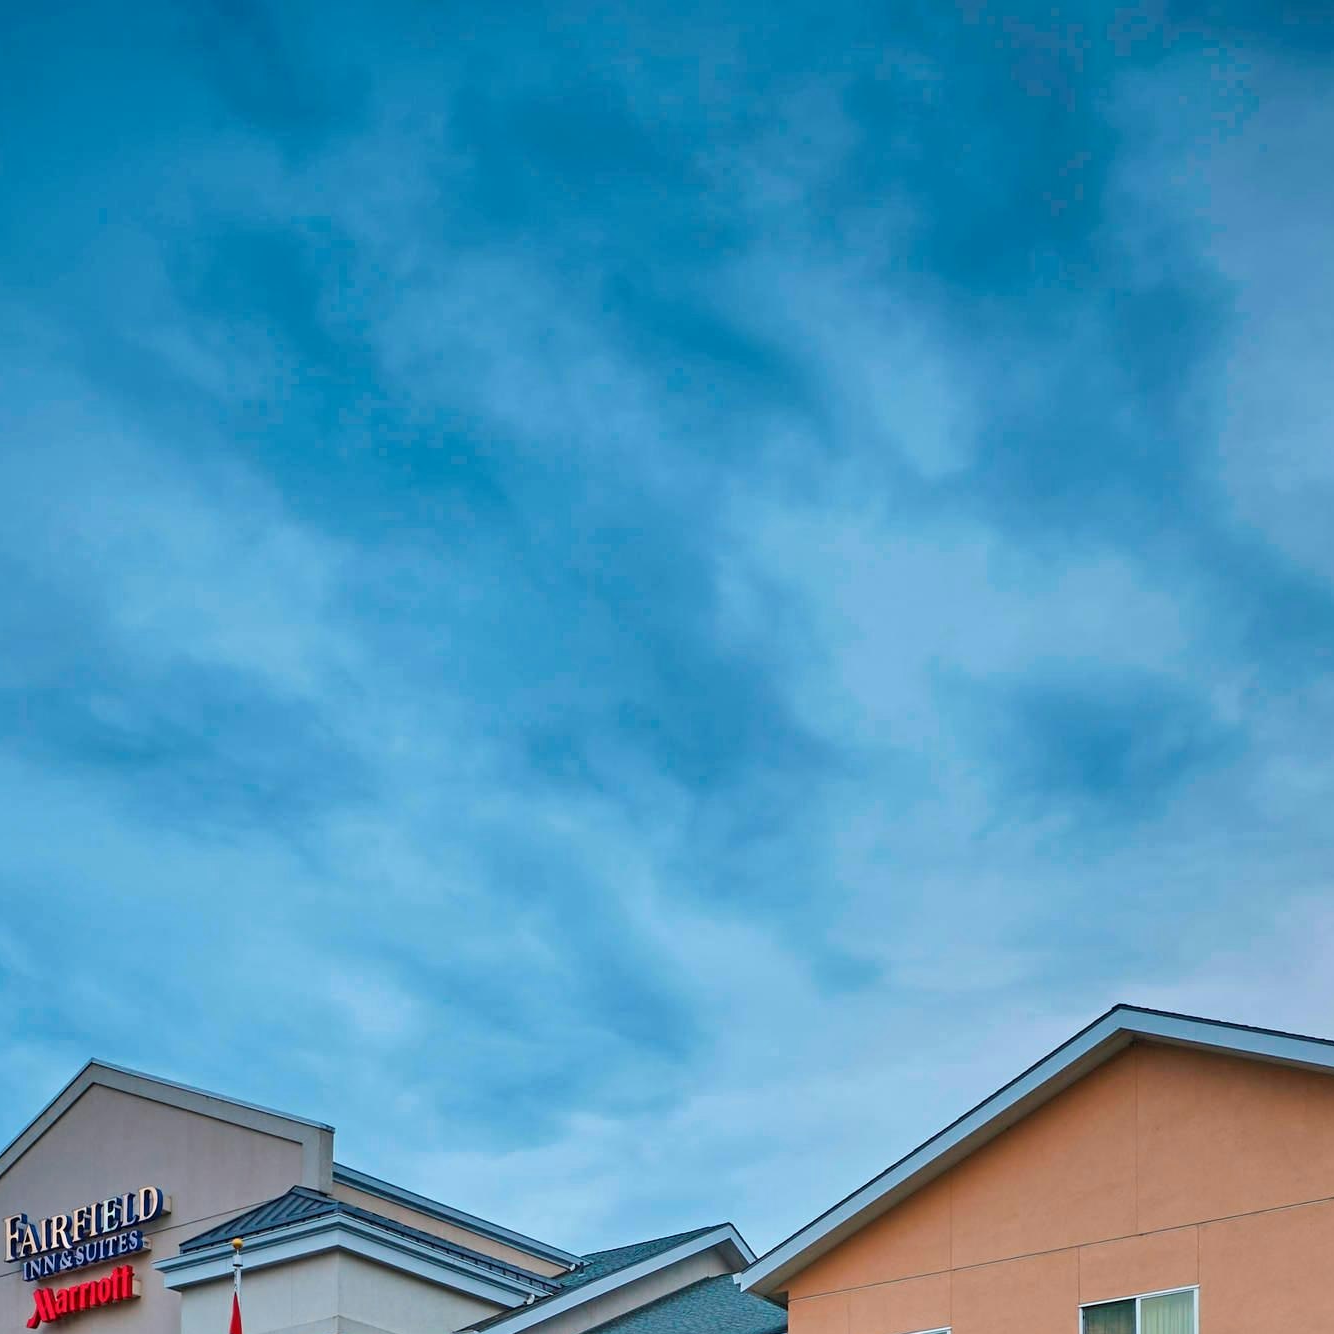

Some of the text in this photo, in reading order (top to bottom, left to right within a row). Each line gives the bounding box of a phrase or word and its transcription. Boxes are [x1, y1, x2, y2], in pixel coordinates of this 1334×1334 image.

[4, 1186, 163, 1262] FAIRFIELD
[23, 1230, 142, 1281] INN & SUITES
[27, 1264, 133, 1328] Marriott
